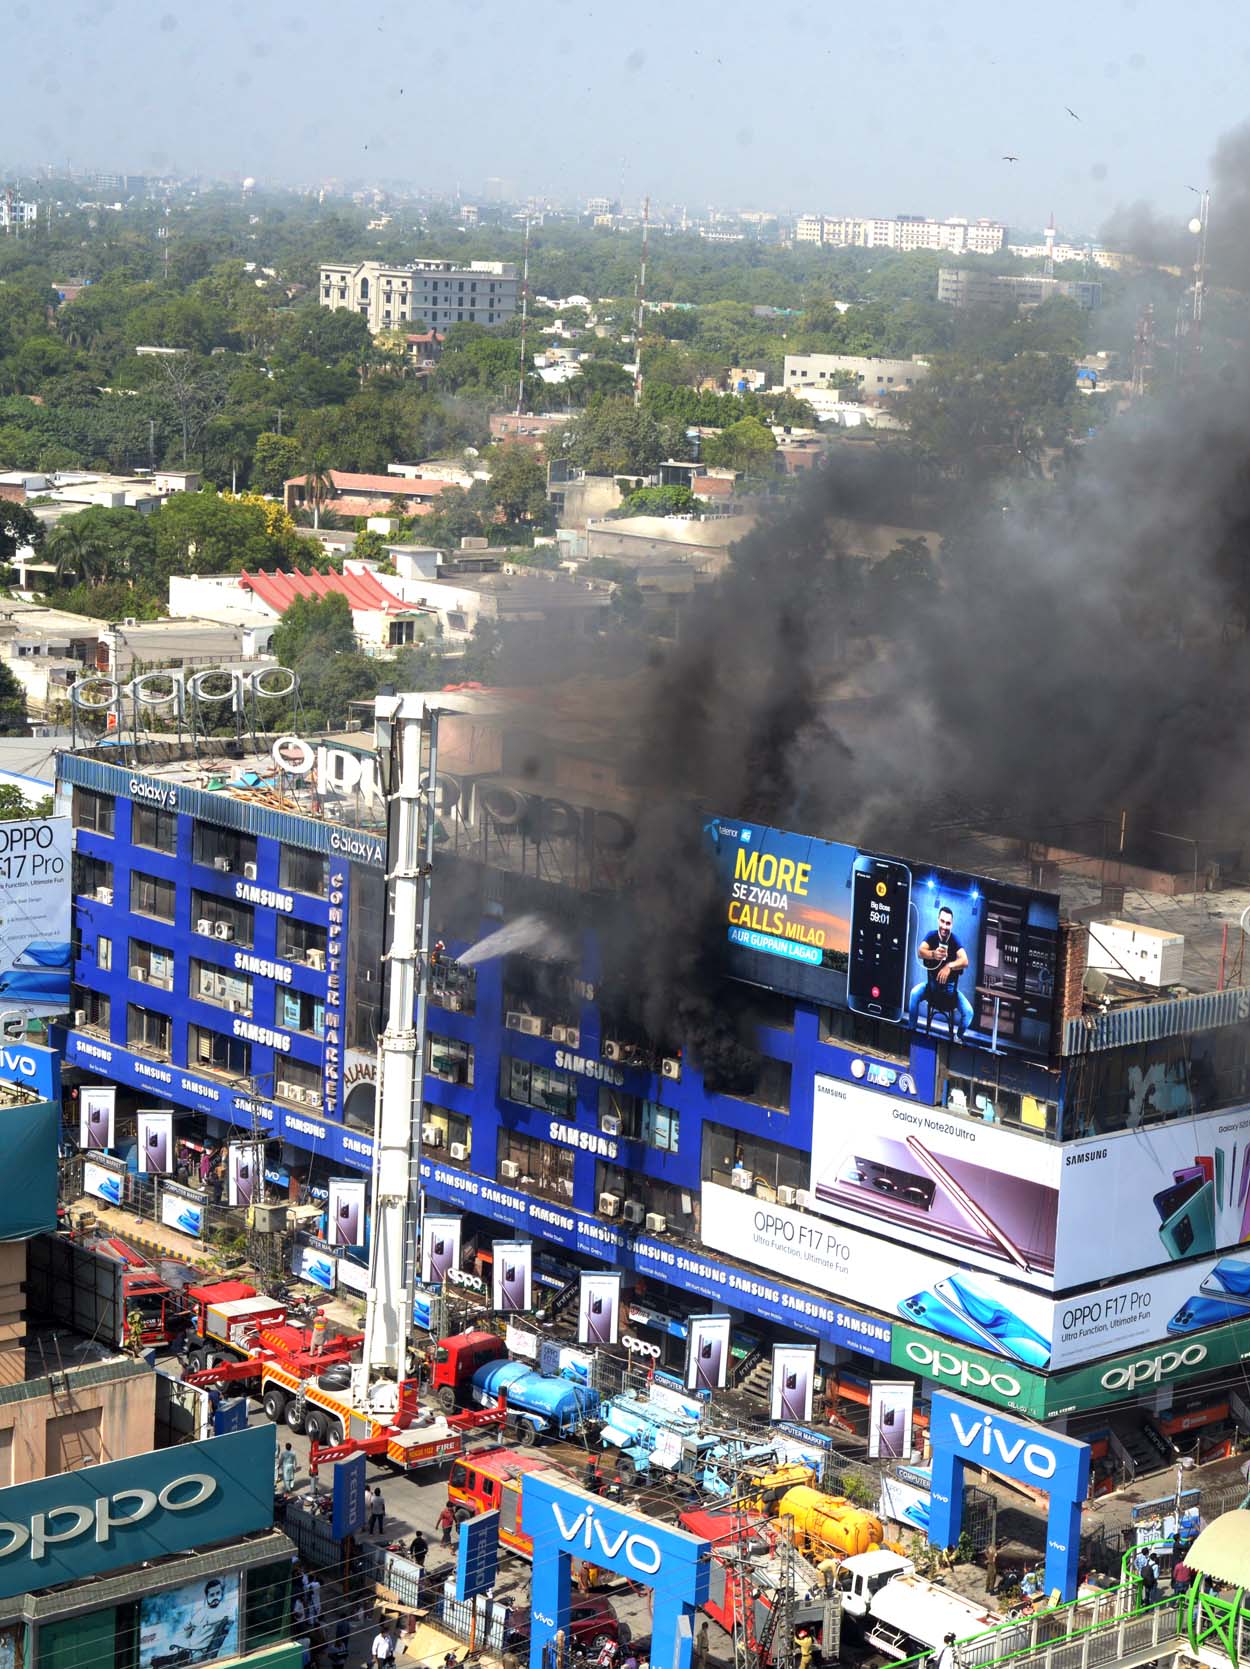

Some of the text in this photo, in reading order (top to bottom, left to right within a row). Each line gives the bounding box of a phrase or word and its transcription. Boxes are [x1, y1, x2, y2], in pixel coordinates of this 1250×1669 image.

[130, 779, 176, 805] Galaxy S
[720, 826, 738, 838] telenor
[331, 833, 383, 863] Galaxy A
[0, 854, 64, 879] 17 Pro
[735, 848, 811, 896] MORE
[236, 882, 293, 912] SAMSUNG
[732, 883, 788, 910] SE ZYADA
[870, 901, 891, 912] Big Boss
[728, 901, 825, 946] CALLS MILAO
[870, 911, 890, 925] 59:01
[731, 929, 818, 960] AUR GUPPAIN LAGAO
[234, 952, 292, 983] SAMSUNG
[325, 873, 344, 1113] COMPUTER MARKET
[233, 1019, 291, 1052] SAMSUNG
[76, 1041, 112, 1062] SAMSUNG
[134, 1062, 171, 1083] SAMSUNG
[555, 1050, 624, 1087] SAMSUNG
[182, 1078, 219, 1101] SAMSUNG
[817, 1084, 847, 1100] SAMSUNG
[285, 1115, 326, 1139] SAMSUNG
[892, 1109, 976, 1142] Galaxy Note20 Ultra
[1218, 1121, 1238, 1134] Galaxy
[343, 1137, 373, 1157] SAMSU
[550, 1122, 618, 1159] SAMSUNG
[1066, 1149, 1107, 1166] SAMSUNG
[434, 1170, 478, 1195] SAMSUNG
[481, 1187, 526, 1212] SAMSUNG
[529, 1205, 574, 1231] SAMSUNG
[578, 1221, 624, 1247] SAMSUNG
[754, 1211, 850, 1260] OPPO F17 Pro
[627, 1240, 675, 1265] SAMSUNG
[753, 1233, 849, 1274] Ultra Function, Ultimate Fun
[448, 1268, 482, 1289] oppo
[677, 1257, 727, 1284] SAMSUNG
[729, 1275, 780, 1303] SAMSUNG
[781, 1294, 834, 1322] SAMSUNG
[1063, 1291, 1151, 1330] OPPO F17 Pro
[837, 1313, 891, 1342] SAMSUNG
[1061, 1332, 1078, 1343] Ultra
[1079, 1324, 1108, 1339] Function,
[1110, 1315, 1137, 1329] Ultimate
[1138, 1311, 1151, 1322] Fun
[622, 1335, 661, 1358] oppo
[739, 1352, 761, 1377] Infinix
[906, 1342, 1021, 1397] oppo
[1101, 1344, 1208, 1391] oppo
[655, 1375, 683, 1391] COMPUTER
[436, 1442, 455, 1453] FIRE
[803, 1432, 826, 1447] MARKET
[950, 1412, 1056, 1479] vivo
[899, 1469, 931, 1487] COMPUTER
[349, 1467, 358, 1525] TECNO
[932, 1492, 949, 1503] vivo
[552, 1502, 661, 1574] vivo
[1048, 1539, 1066, 1552] vivo
[533, 1611, 554, 1627] vivo
